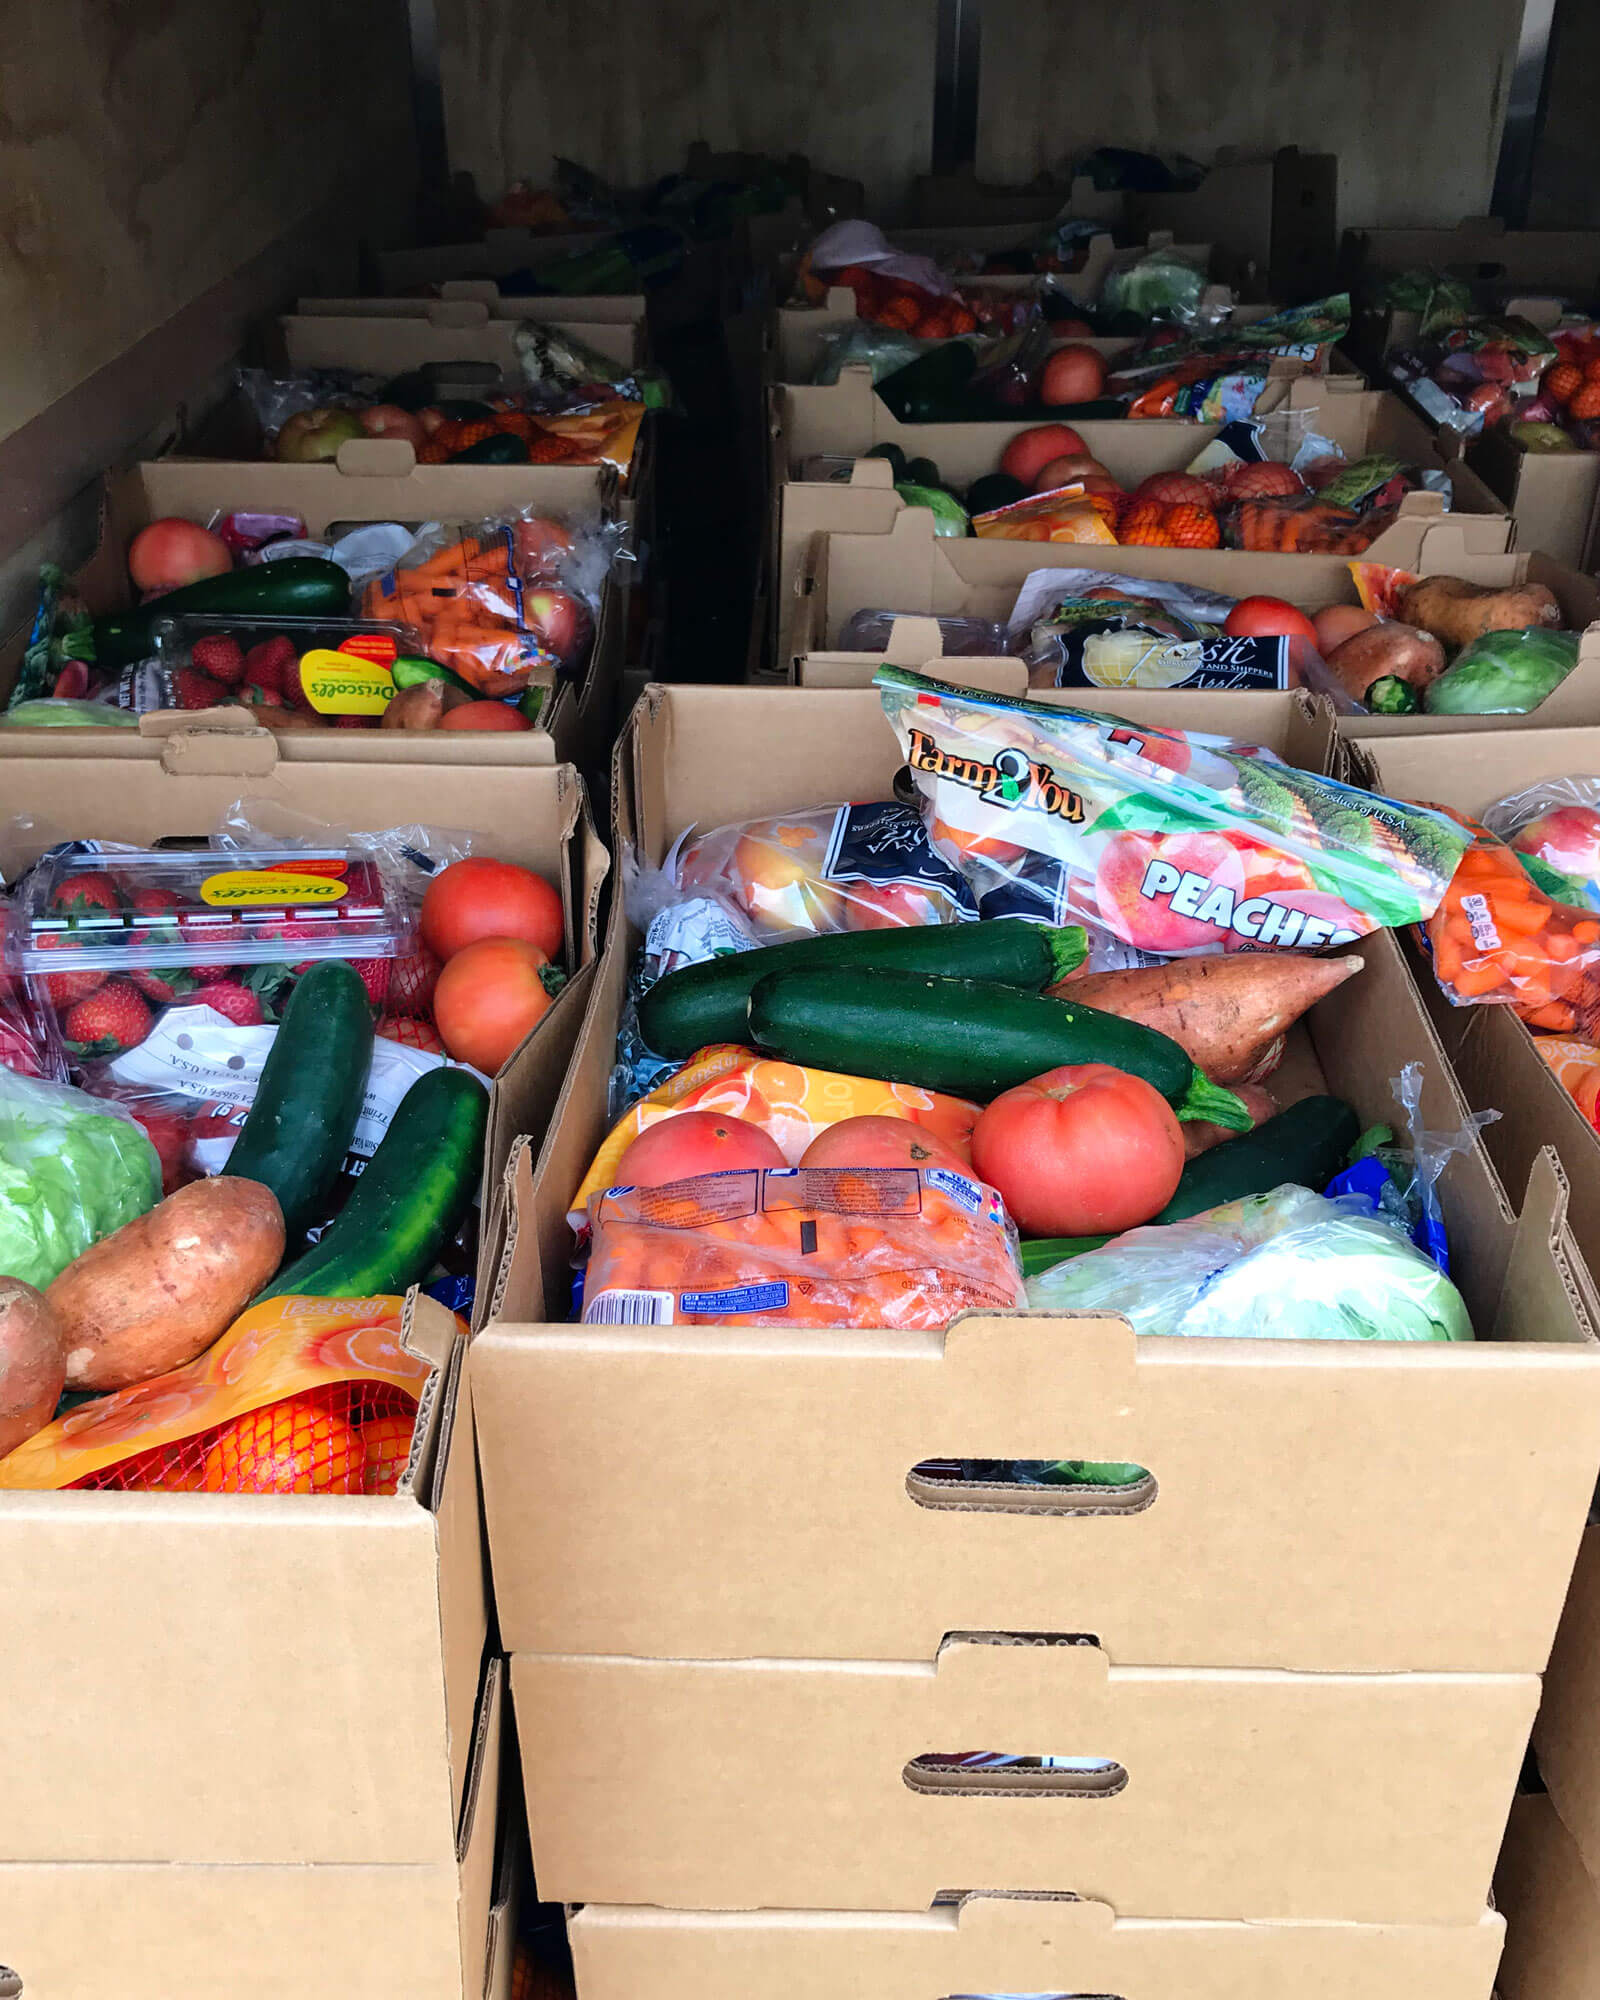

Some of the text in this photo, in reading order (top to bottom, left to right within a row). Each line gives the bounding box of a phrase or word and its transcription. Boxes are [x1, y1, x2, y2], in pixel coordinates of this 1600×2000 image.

[311, 683, 395, 701] Driscoll's
[1314, 787, 1409, 831] Product of U.S.A.
[213, 886, 335, 898] Driscoll's
